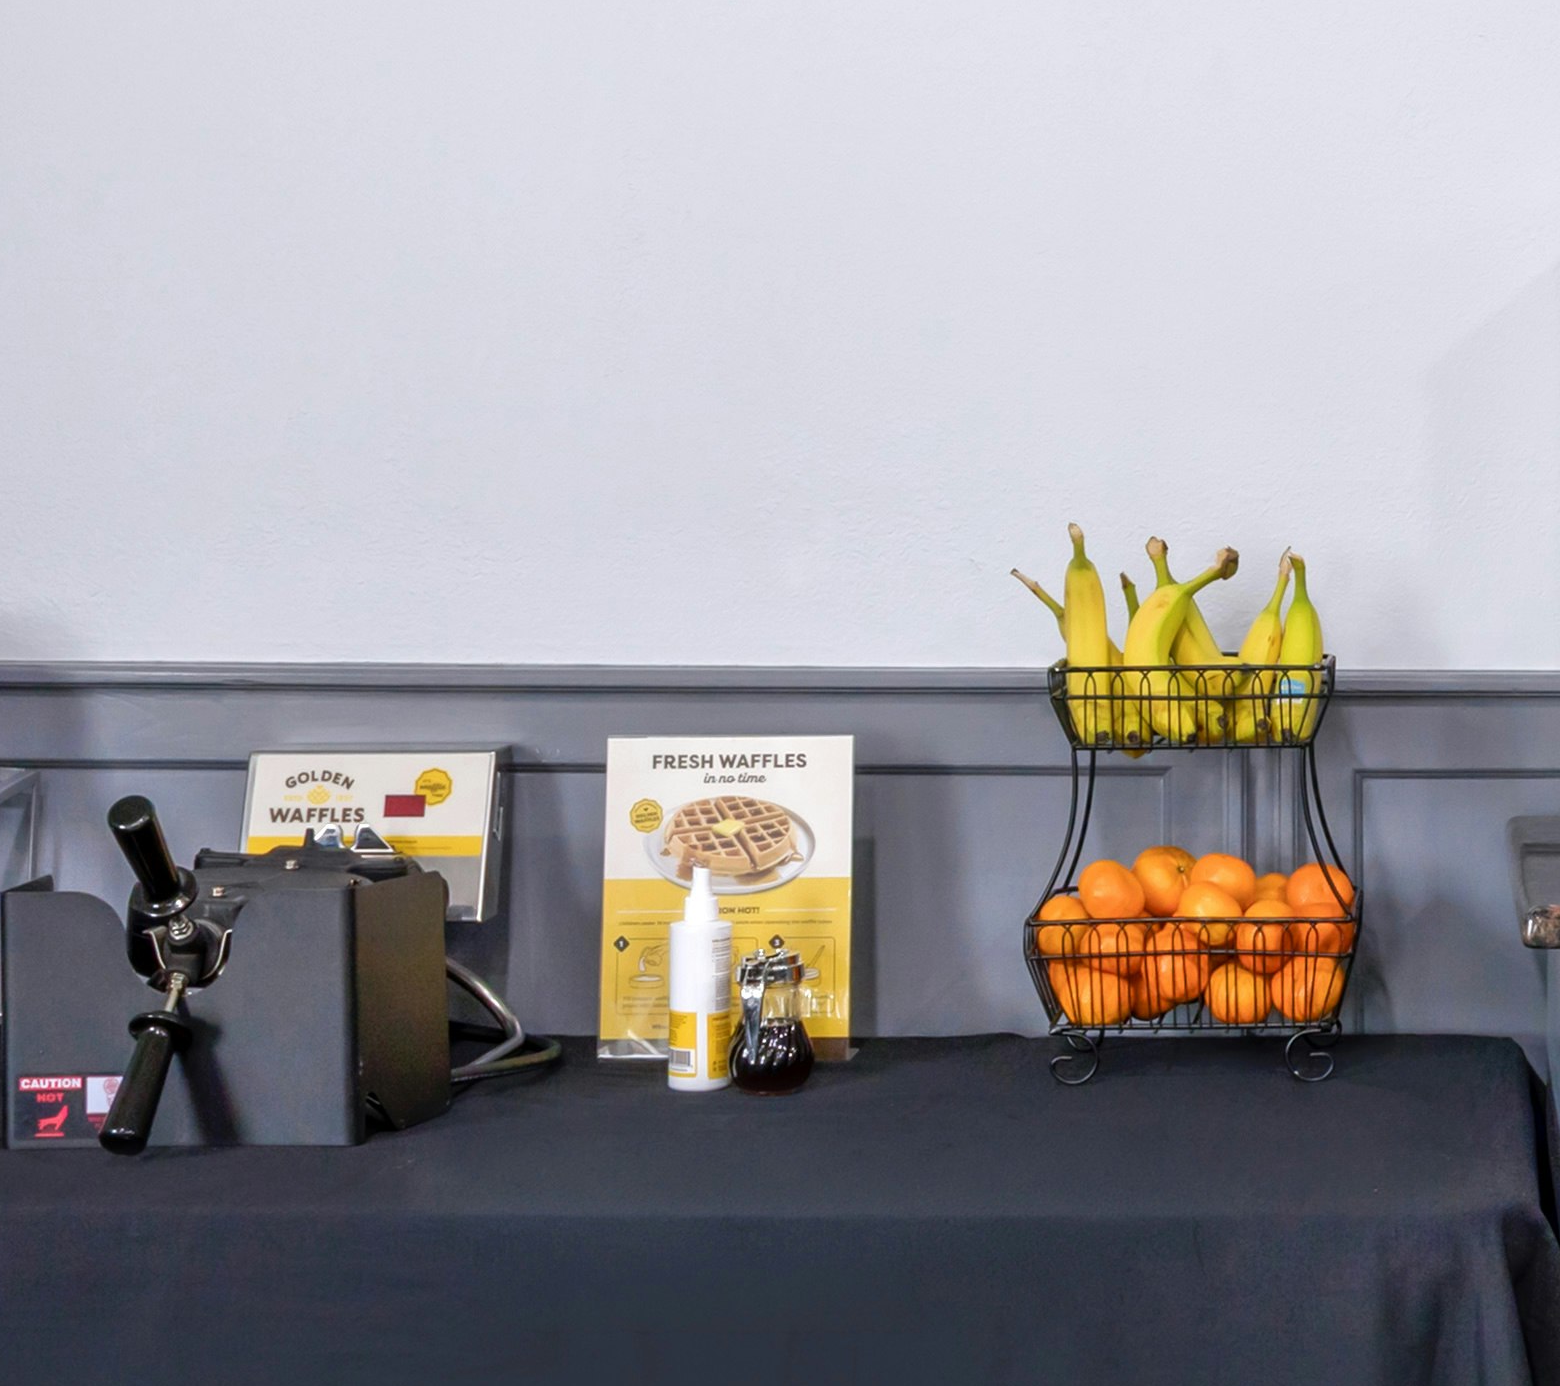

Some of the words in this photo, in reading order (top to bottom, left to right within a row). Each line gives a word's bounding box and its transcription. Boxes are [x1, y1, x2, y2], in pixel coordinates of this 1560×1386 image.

[651, 754, 714, 769] FRESH
[718, 753, 808, 769] WAFFLES
[284, 769, 356, 791] GOLDEN
[703, 772, 717, 784] in
[718, 774, 736, 784] no
[737, 772, 767, 784] time
[269, 807, 365, 823] WAFFLES
[20, 1078, 82, 1089] CAUTION
[36, 1093, 65, 1103] HOT
